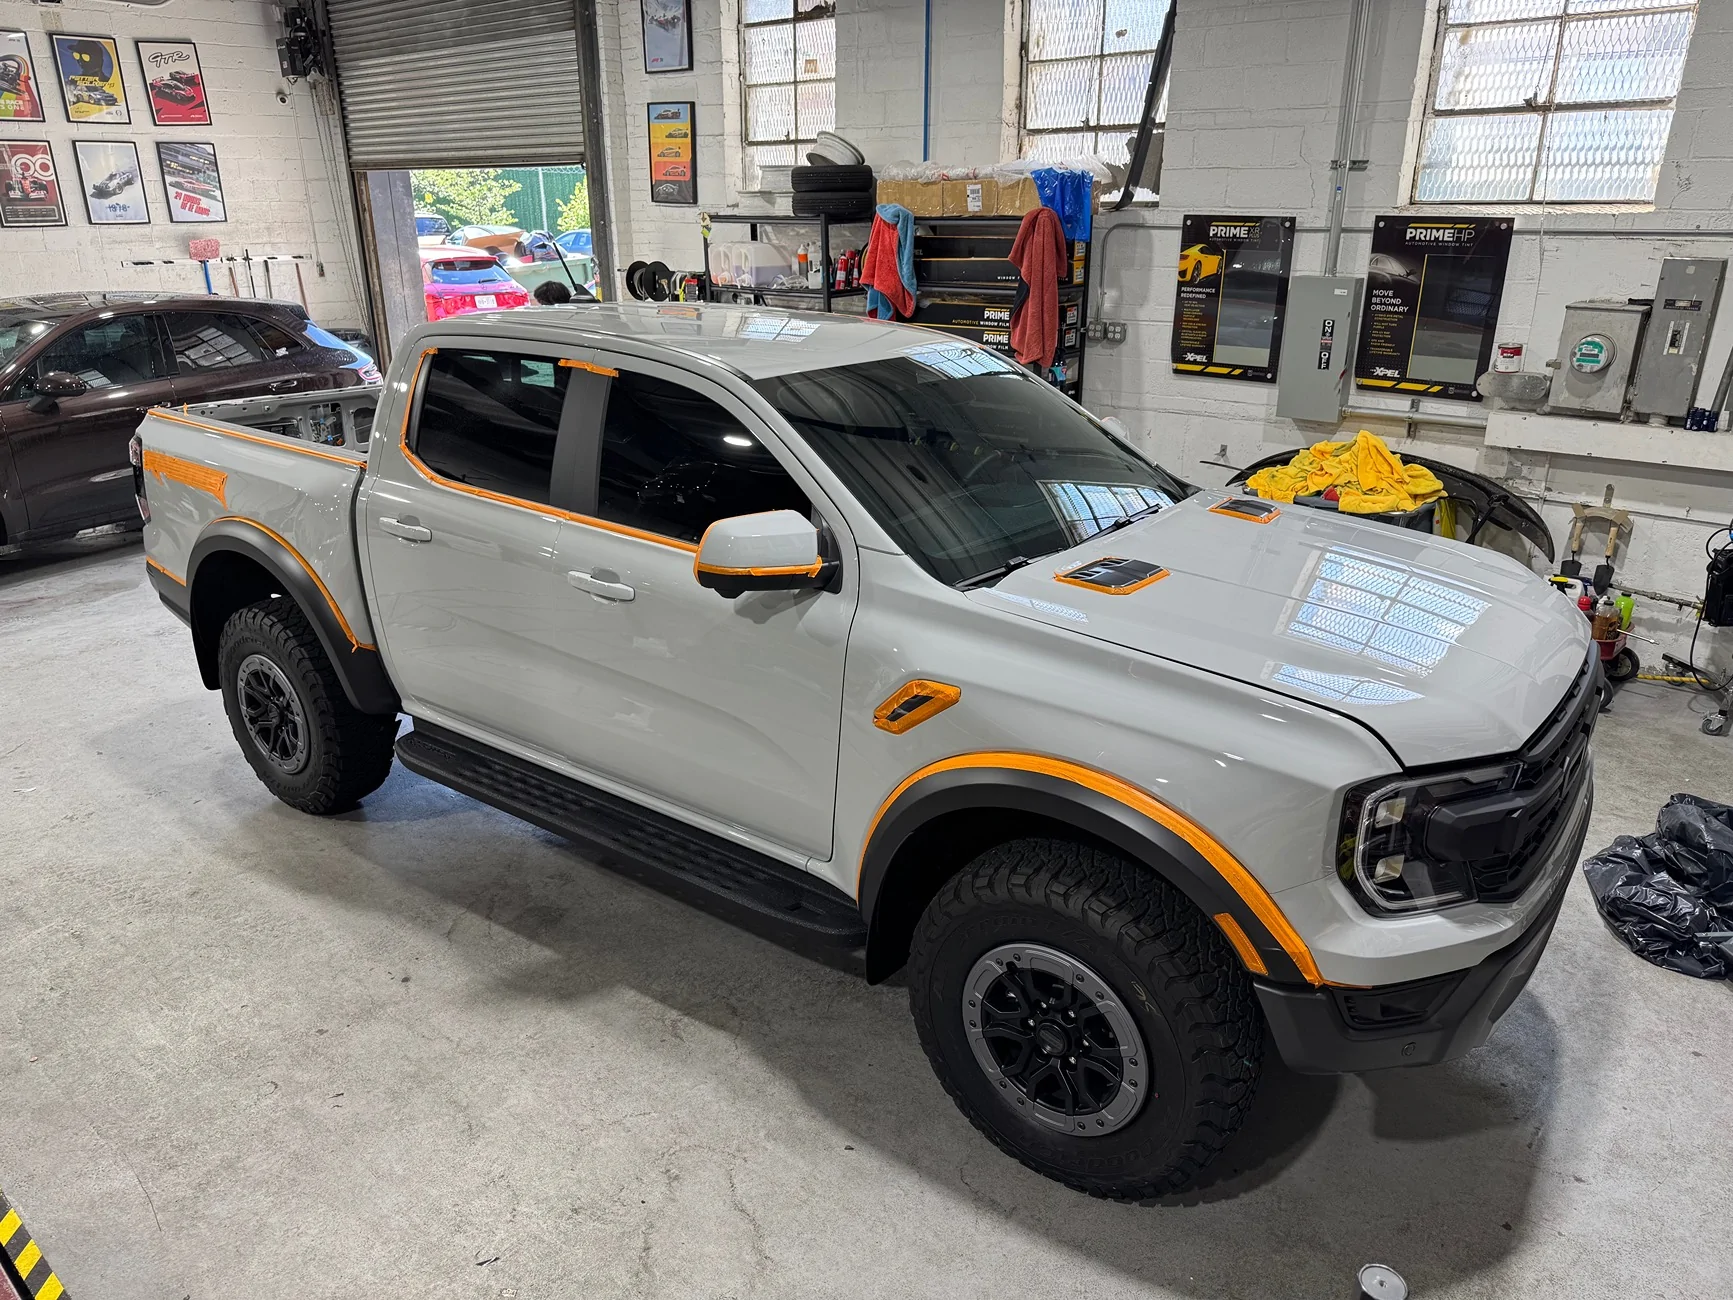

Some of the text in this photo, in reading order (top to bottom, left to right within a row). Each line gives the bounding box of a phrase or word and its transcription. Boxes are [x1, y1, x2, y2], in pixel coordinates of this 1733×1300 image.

[1210, 226, 1249, 238] PRIME
[984, 310, 1010, 320] PRIME
[983, 334, 1009, 343] PRIME
[1184, 352, 1208, 362] XPEL
[1373, 367, 1400, 377] XPEL
